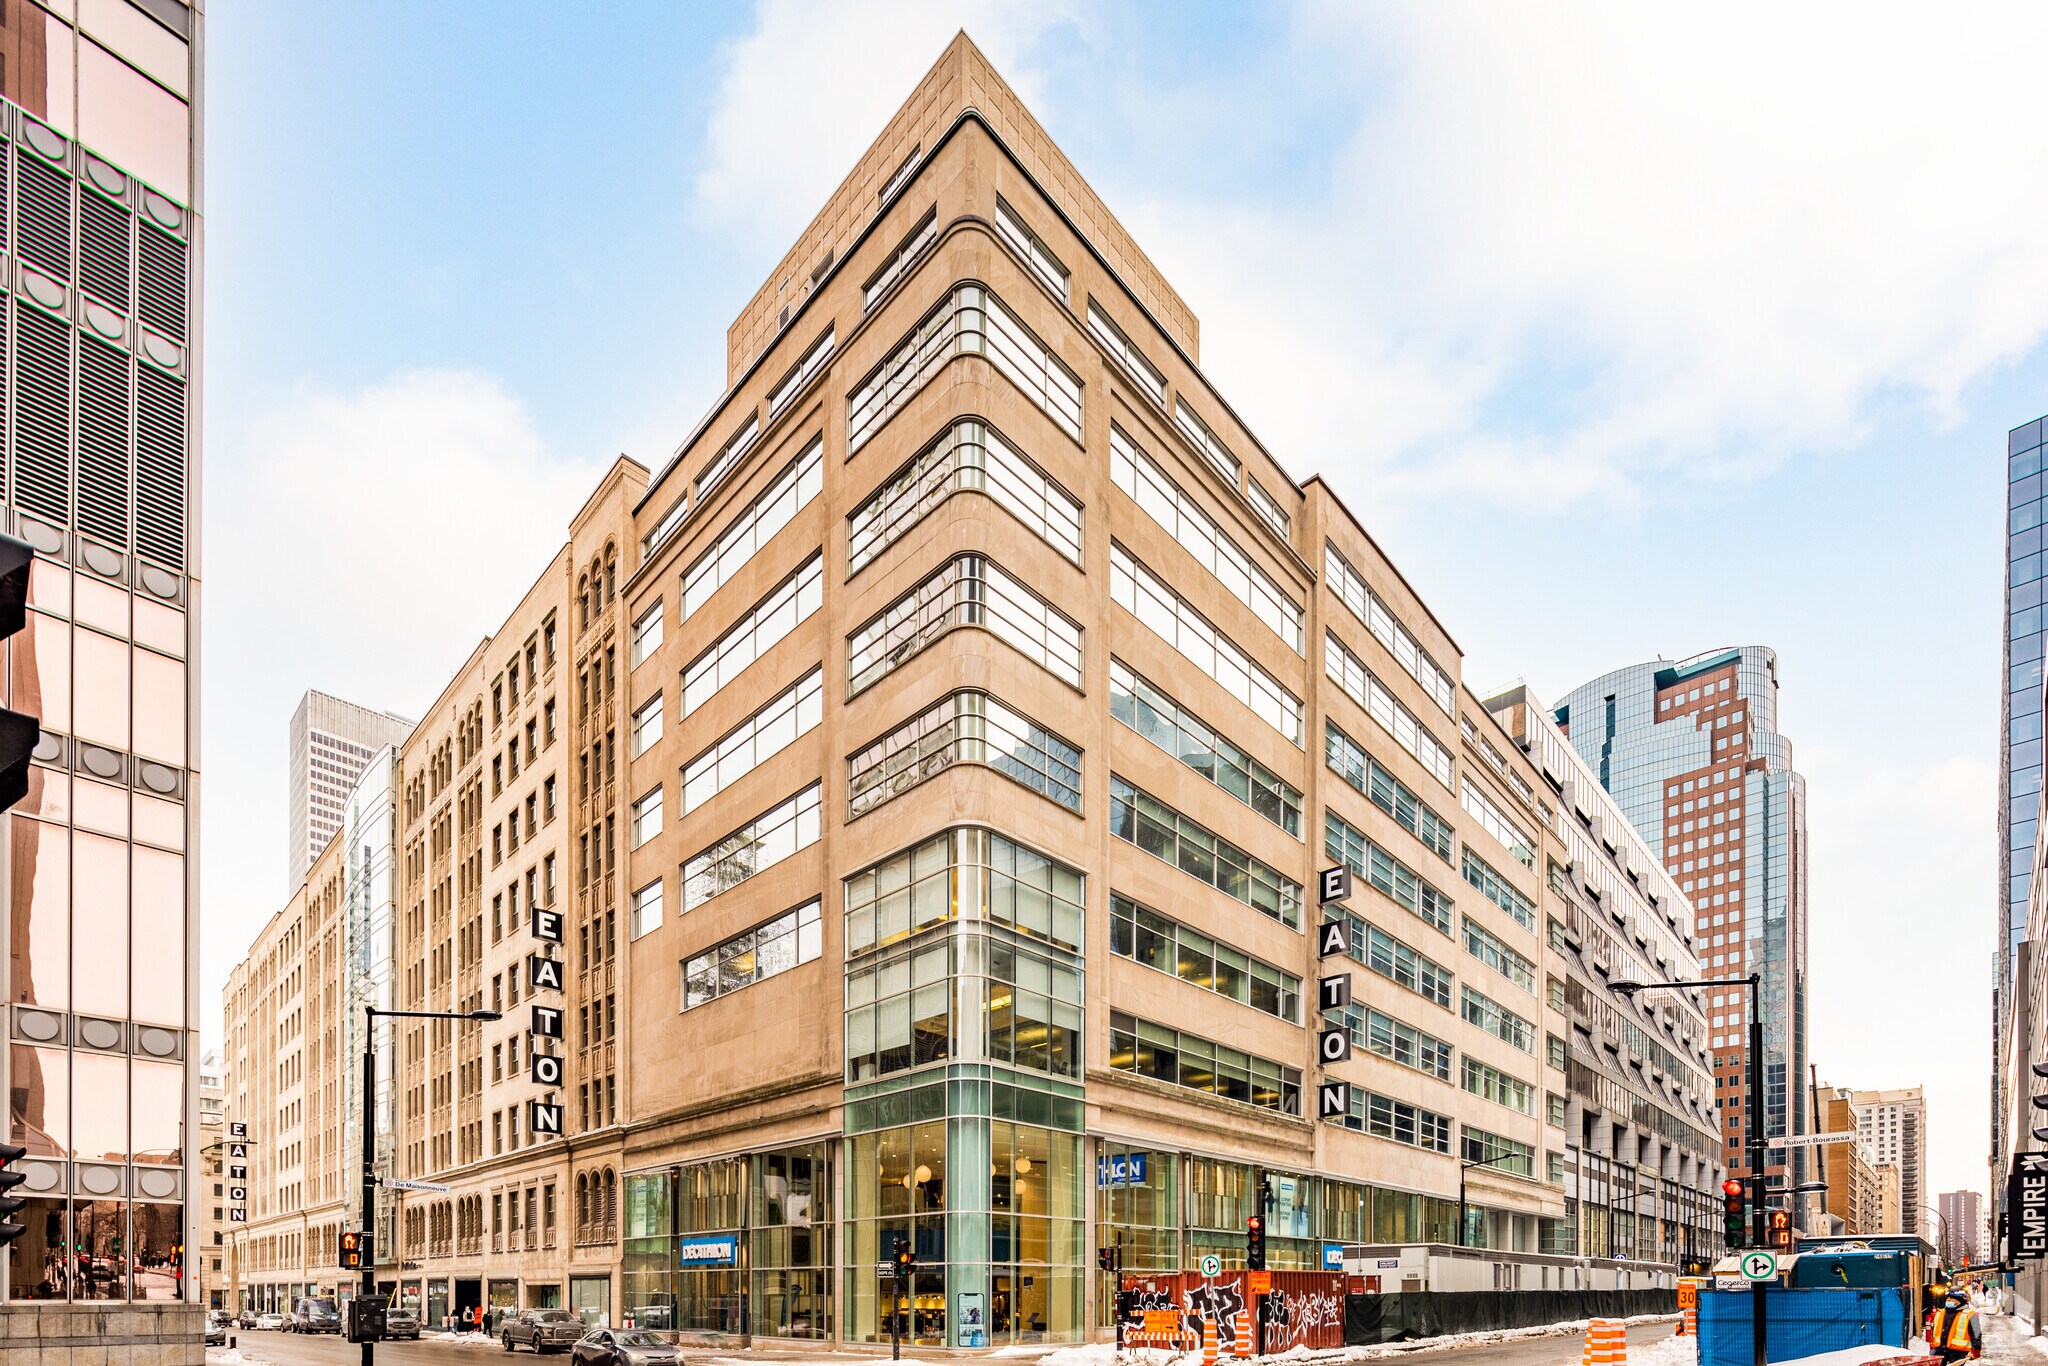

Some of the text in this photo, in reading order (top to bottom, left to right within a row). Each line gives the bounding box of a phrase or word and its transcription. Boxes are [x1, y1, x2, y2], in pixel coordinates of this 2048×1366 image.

[536, 911, 559, 1132] EATON
[1323, 868, 1346, 1114] EATON
[232, 1123, 245, 1221] EATON
[1783, 1135, 1850, 1146] Robert-Bourassa
[406, 1183, 447, 1192] Maisonneuve
[2023, 1176, 2046, 1250] EMPIRE
[1680, 1291, 1695, 1304] 30
